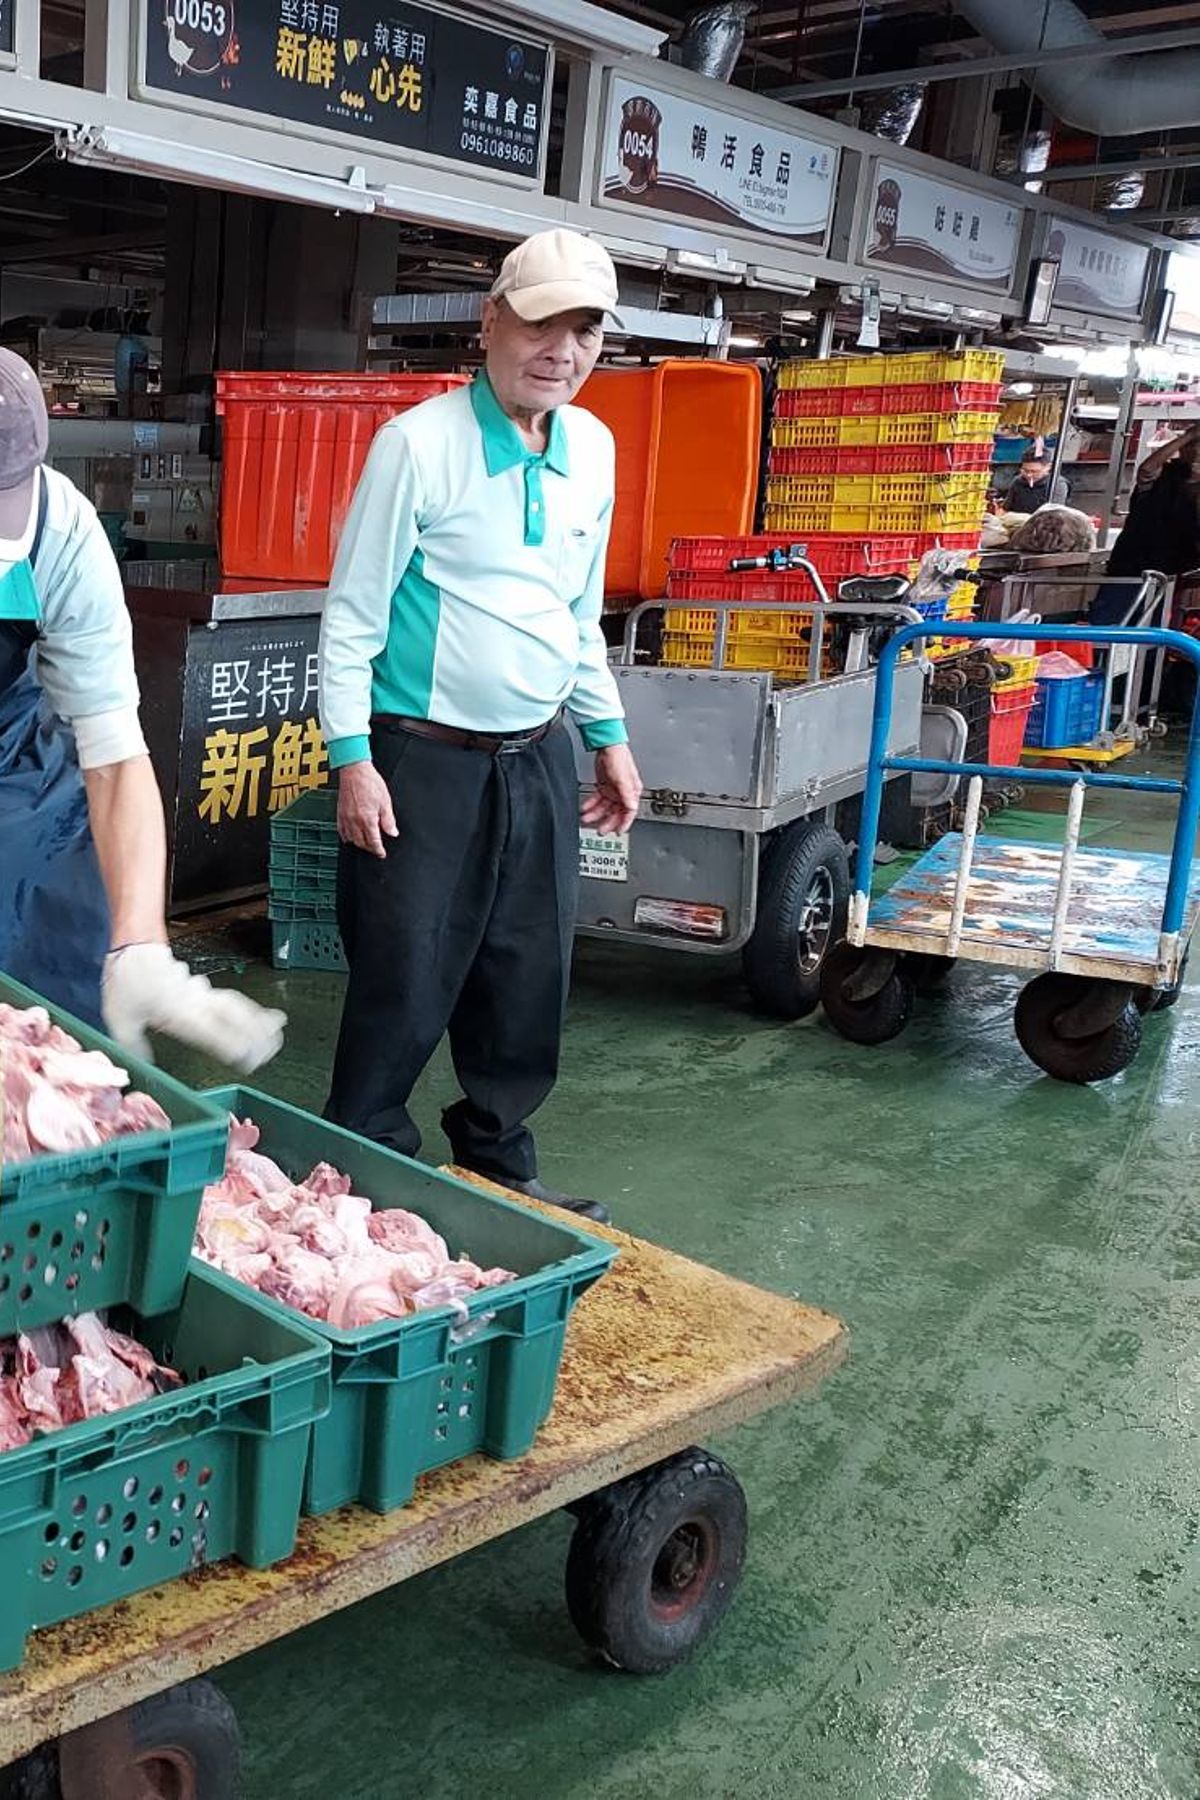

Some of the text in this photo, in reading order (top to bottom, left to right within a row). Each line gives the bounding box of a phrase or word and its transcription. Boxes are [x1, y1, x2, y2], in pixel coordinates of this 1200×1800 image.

[174, 0, 226, 36] 0053
[276, 26, 337, 89] 新鮮
[373, 20, 426, 65] 執著用
[369, 56, 422, 112] 心先
[463, 86, 537, 130] 奕嘉食品
[461, 132, 534, 165] 0961089860
[623, 129, 654, 159] 0054
[197, 717, 329, 824] 新鮮
